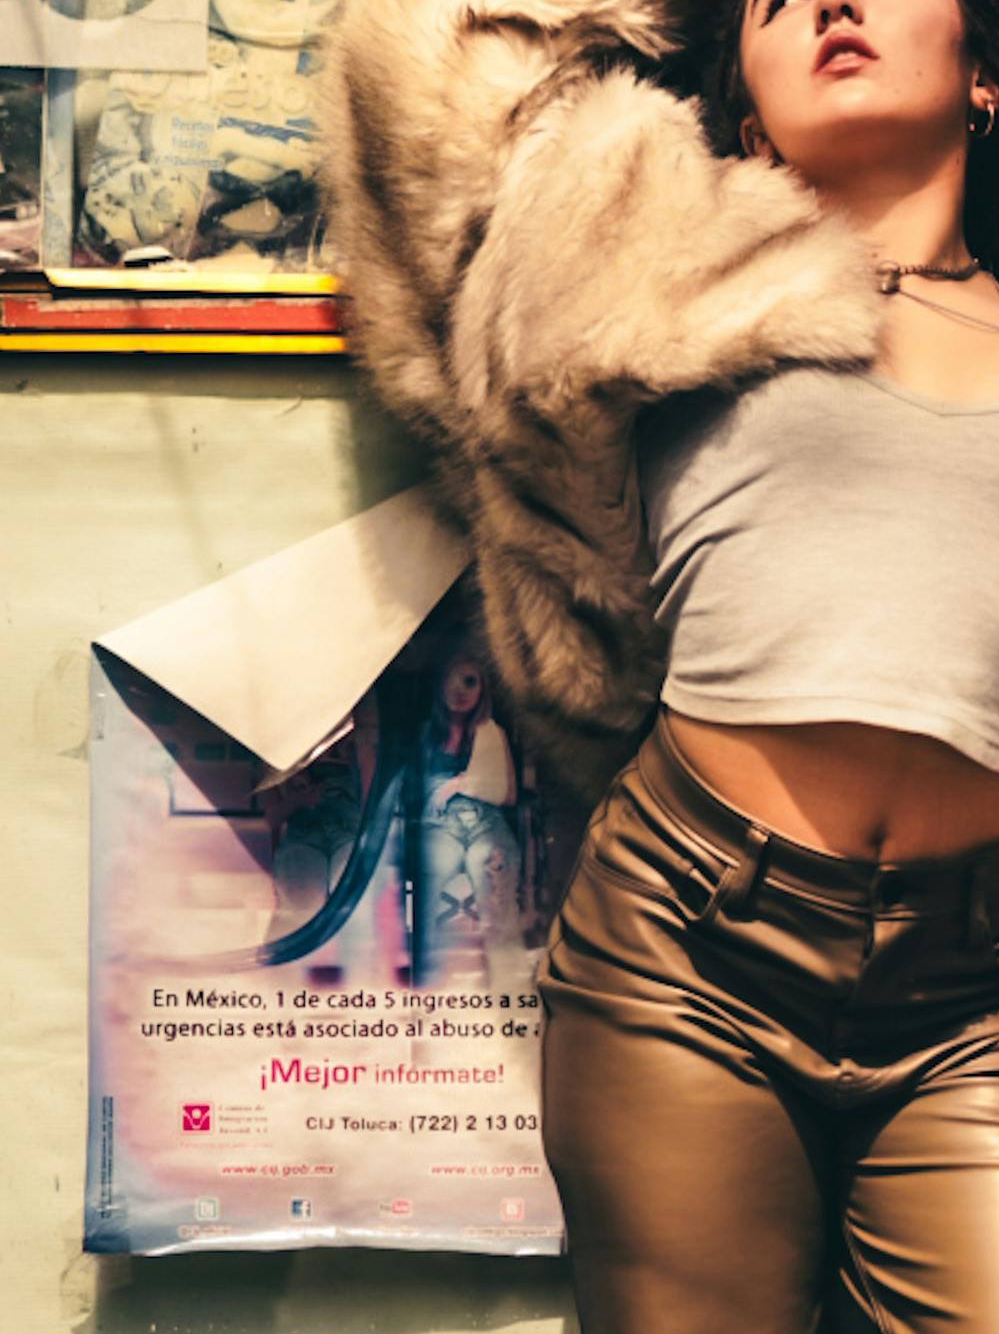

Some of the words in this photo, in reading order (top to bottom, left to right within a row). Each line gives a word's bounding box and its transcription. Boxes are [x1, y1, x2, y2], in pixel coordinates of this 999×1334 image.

[153, 989, 179, 1009] En
[186, 989, 267, 1011] México,
[277, 990, 285, 1009] 1
[293, 989, 320, 1009] de
[327, 989, 377, 1009] cada
[385, 991, 396, 1009] 5
[402, 991, 493, 1019] ingresos
[500, 995, 511, 1010] a
[141, 1020, 246, 1041] urgencias
[253, 1018, 297, 1038] está
[303, 1019, 399, 1039] asociado
[405, 1019, 424, 1038] al
[430, 1020, 495, 1038] abuso
[501, 1019, 528, 1038] de
[260, 1058, 368, 1092] ¡Mejor
[375, 1062, 505, 1085] infórmate!
[305, 1117, 335, 1131] CIJ
[342, 1117, 404, 1131] Toluca:
[408, 1114, 459, 1133] (722)
[465, 1116, 478, 1131] 2
[486, 1115, 508, 1131] 13
[515, 1115, 539, 1131] 03
